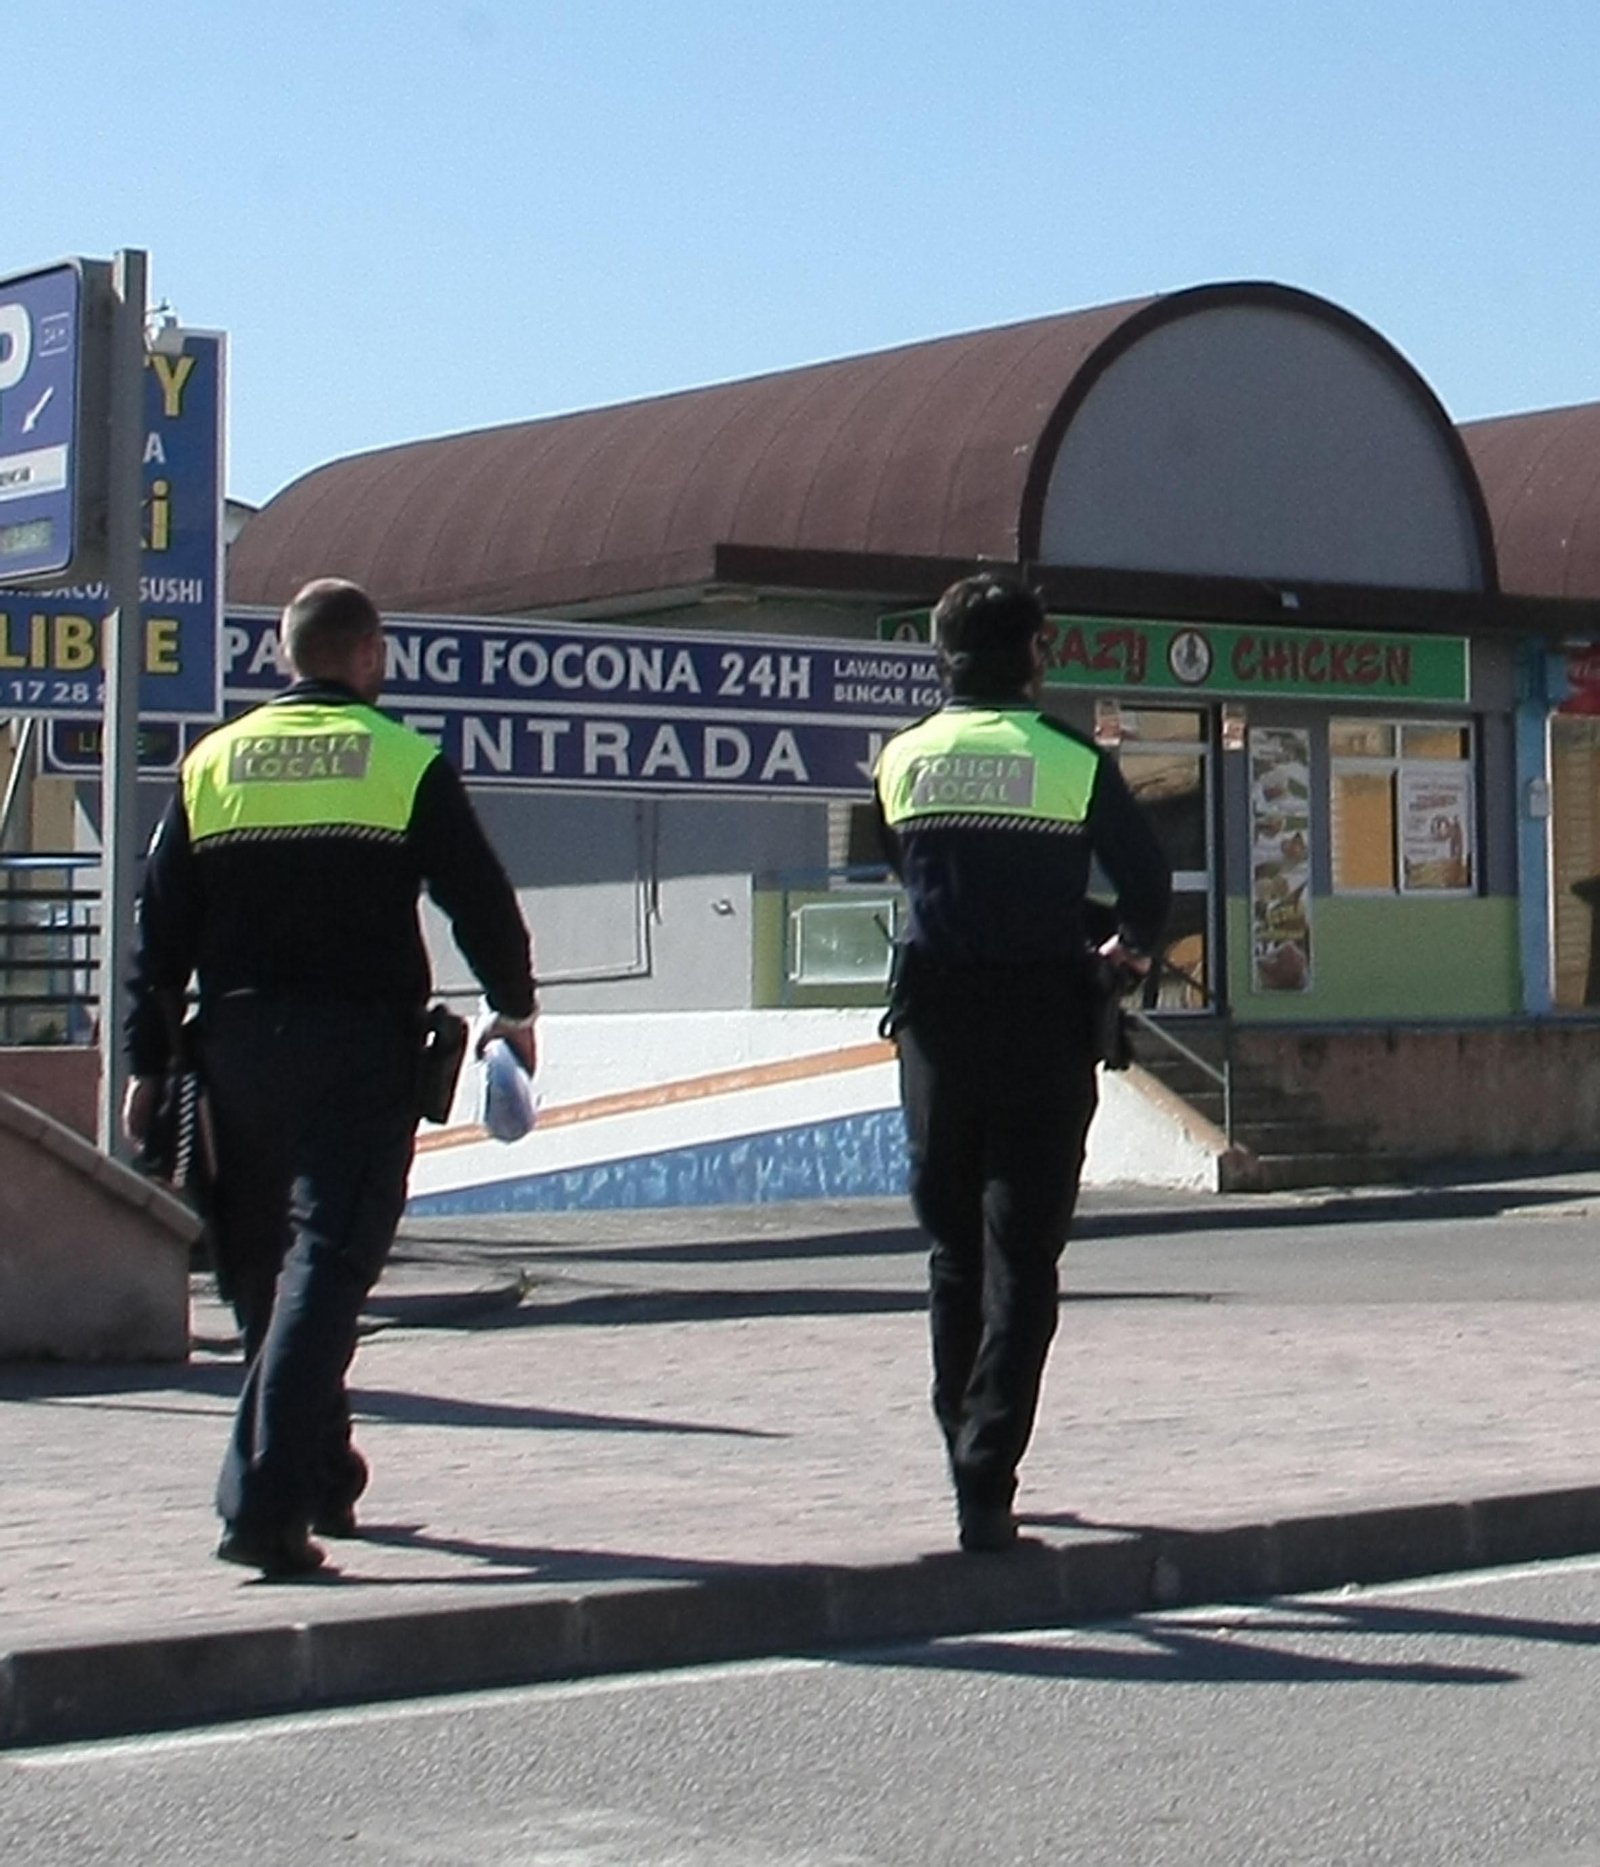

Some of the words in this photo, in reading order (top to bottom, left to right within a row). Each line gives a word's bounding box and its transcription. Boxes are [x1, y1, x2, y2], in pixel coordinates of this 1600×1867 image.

[139, 577, 203, 603] SUSHI
[0, 613, 179, 673] LIBE
[481, 640, 701, 694] FOCONA
[718, 652, 812, 699] 24H
[834, 659, 907, 680] LAVADO
[1232, 634, 1412, 686] CHICKEN
[10, 681, 45, 702] 17
[53, 682, 90, 703] 28
[245, 755, 342, 777] LOCAL
